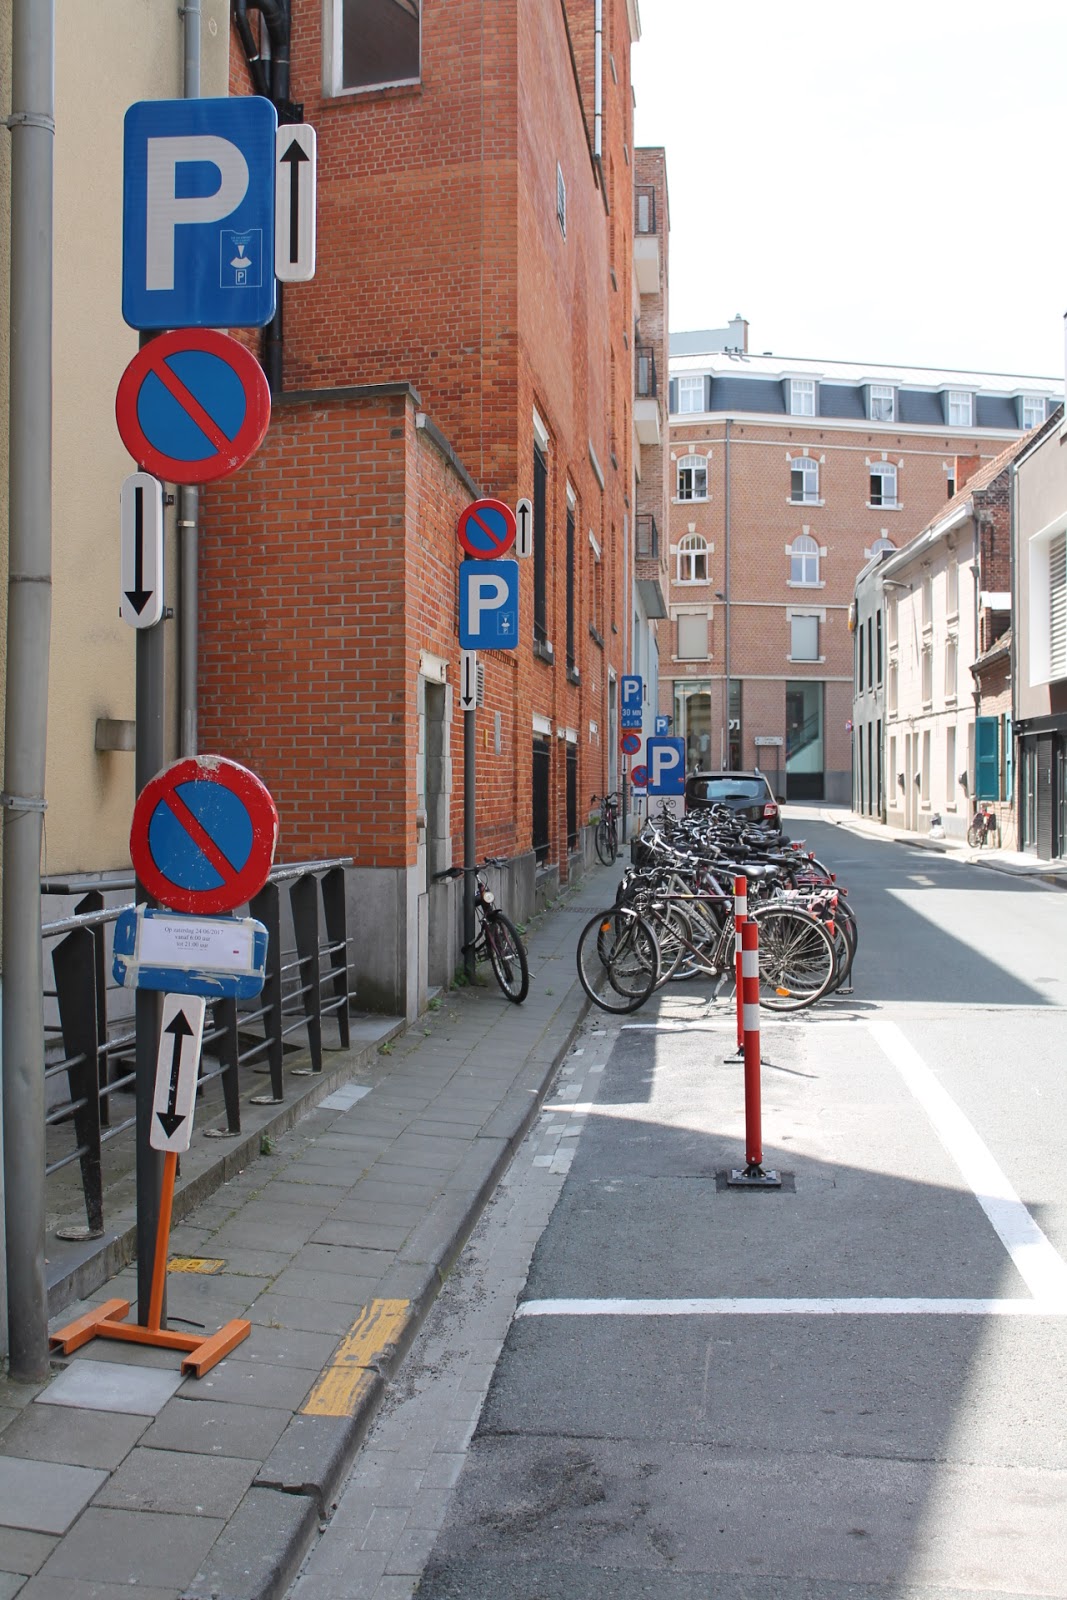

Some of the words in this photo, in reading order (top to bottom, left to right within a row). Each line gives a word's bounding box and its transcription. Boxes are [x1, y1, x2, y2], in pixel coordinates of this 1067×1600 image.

[146, 135, 249, 291] P
[237, 271, 245, 283] P
[468, 575, 509, 635] P
[624, 680, 640, 702] P
[656, 719, 667, 733] P
[652, 746, 680, 787] P
